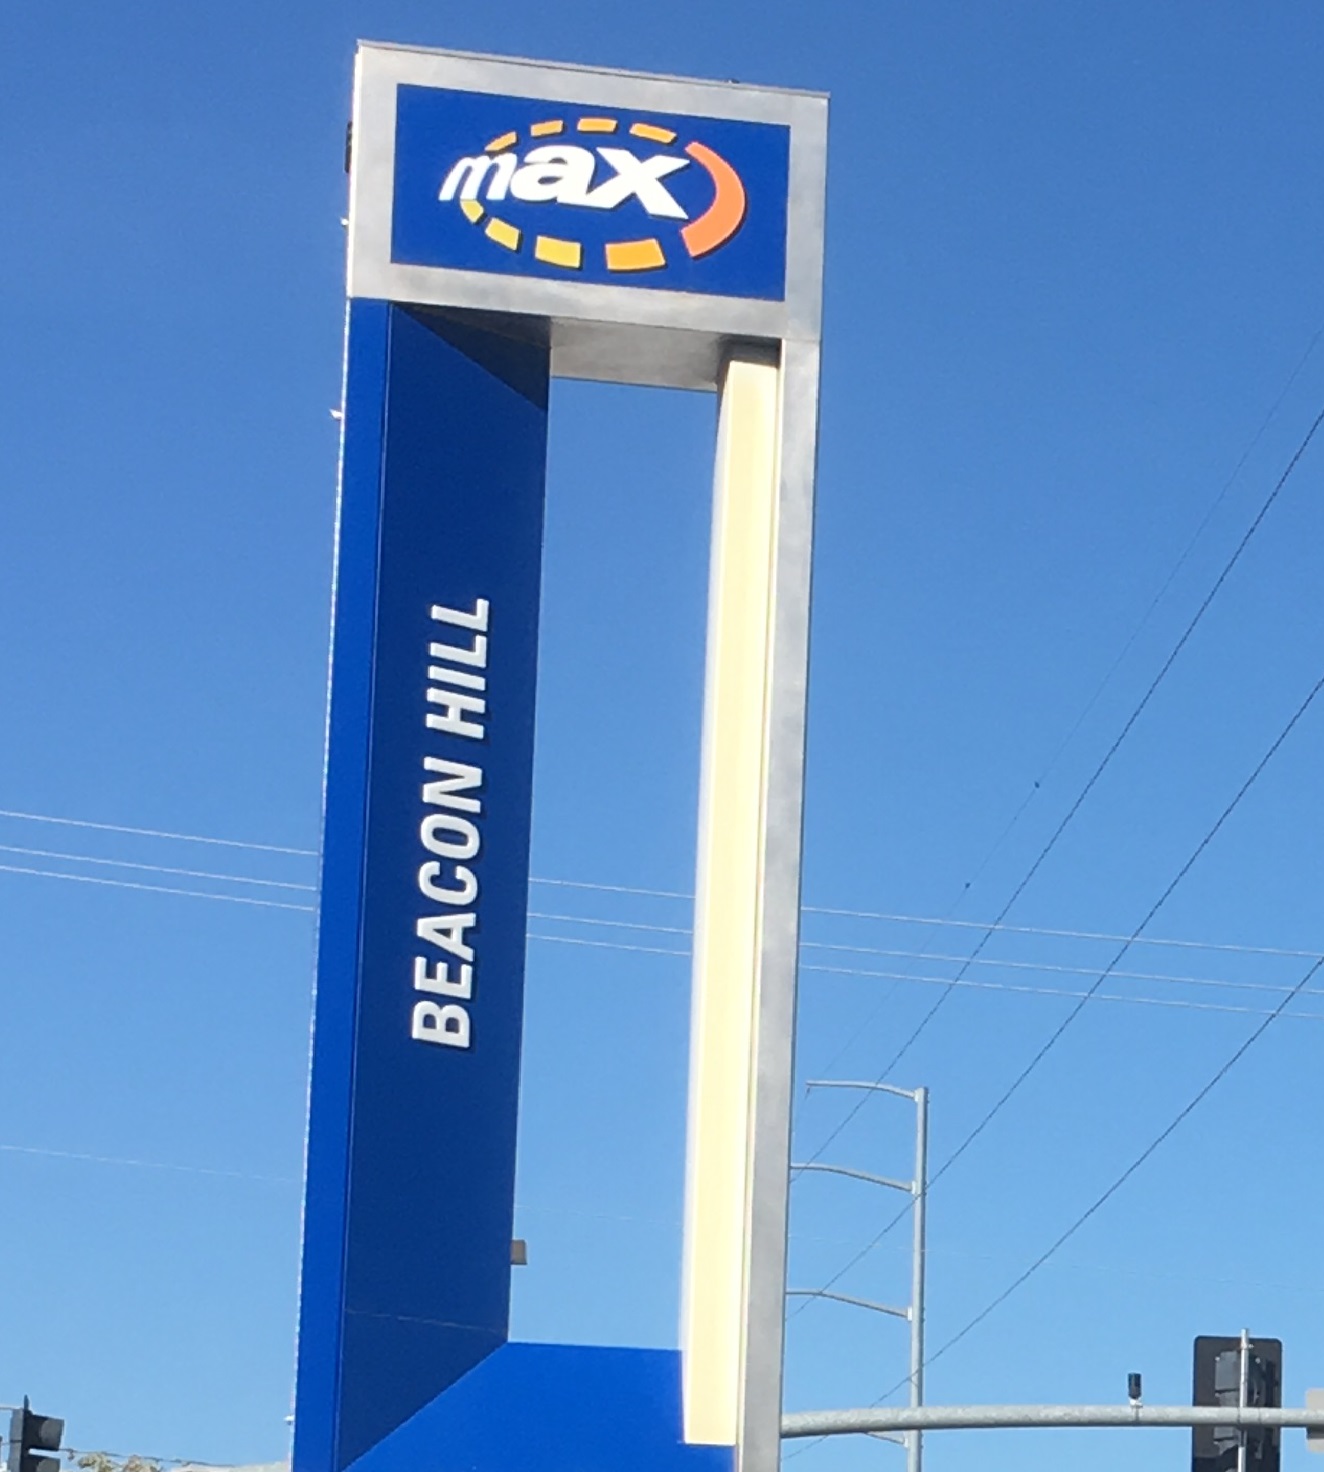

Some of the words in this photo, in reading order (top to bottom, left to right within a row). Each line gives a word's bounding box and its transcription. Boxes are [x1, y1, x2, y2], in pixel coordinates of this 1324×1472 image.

[438, 145, 692, 220] max
[426, 597, 490, 740] HILL
[411, 756, 483, 1049] BEACON
